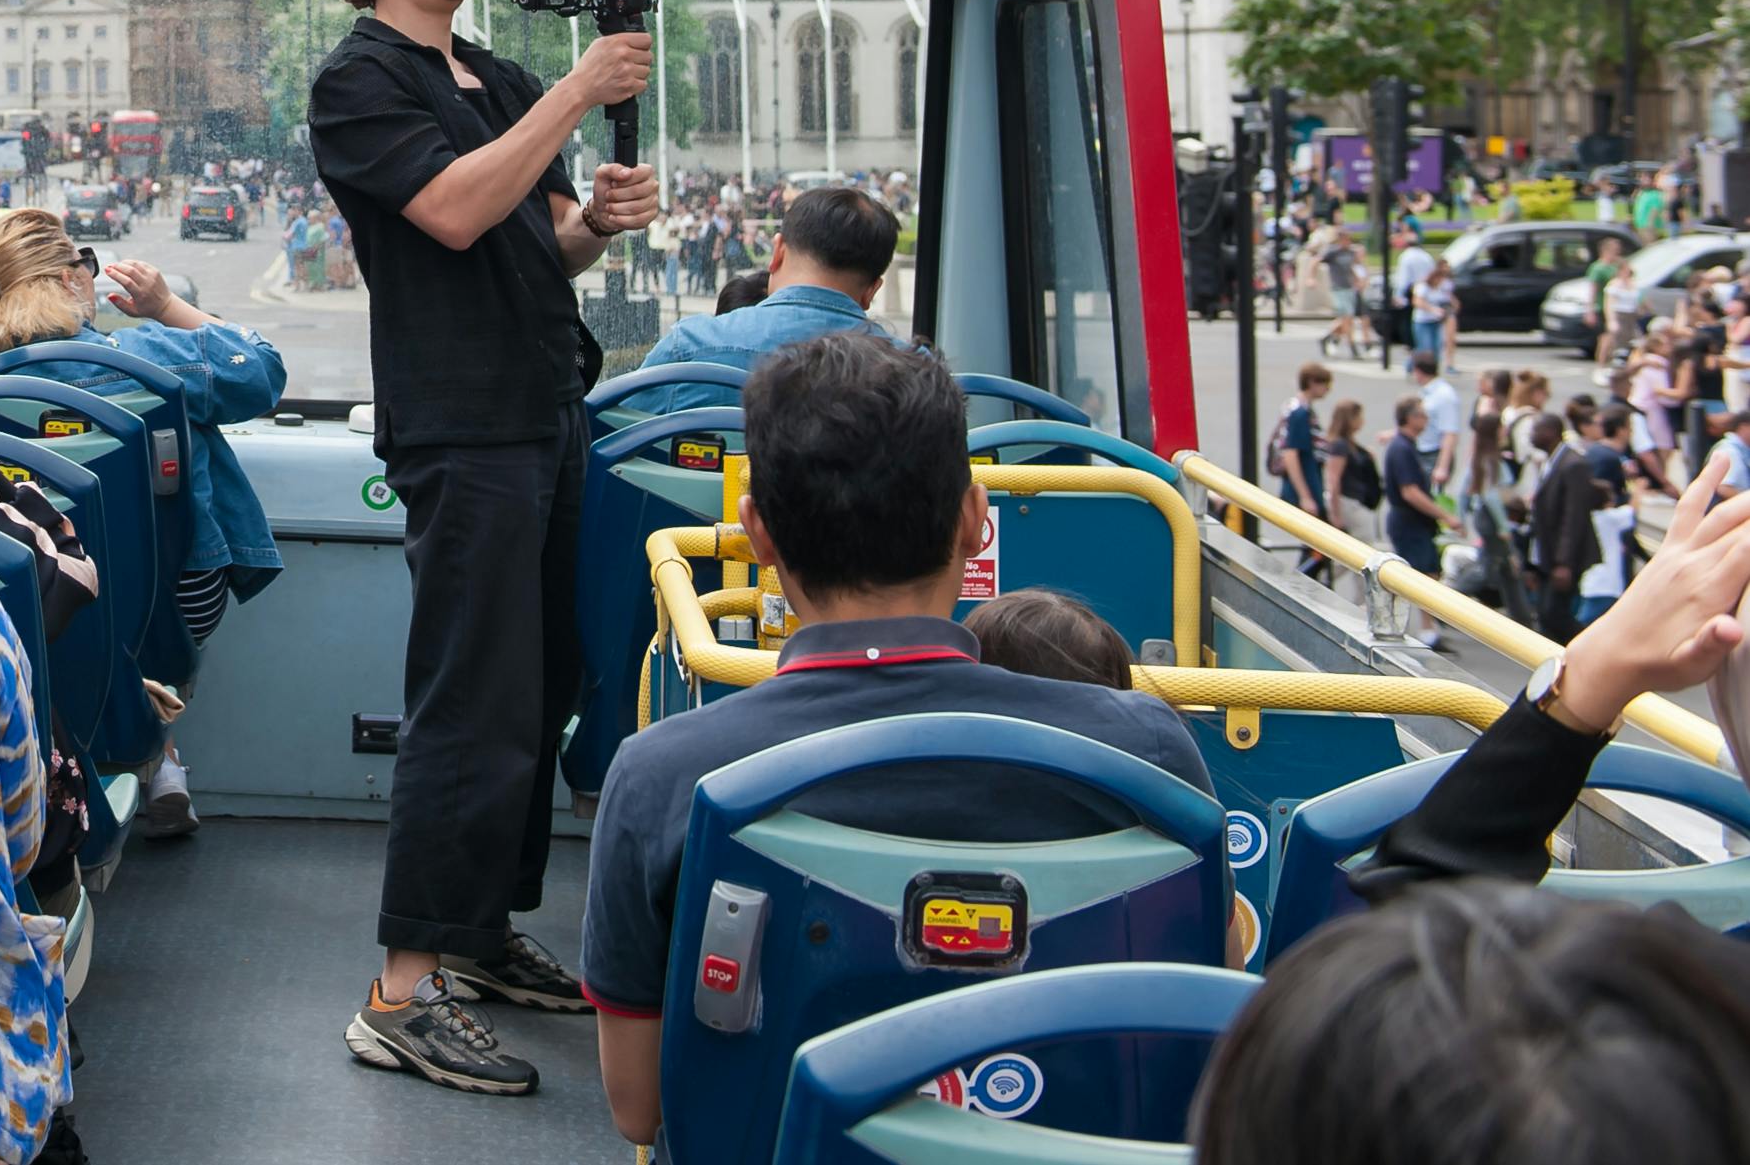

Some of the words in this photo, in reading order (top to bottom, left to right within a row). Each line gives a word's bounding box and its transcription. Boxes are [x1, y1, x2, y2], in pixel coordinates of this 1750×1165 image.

[965, 561, 979, 570] No
[963, 570, 993, 580] oking
[927, 916, 962, 925] CHANNEL
[708, 968, 732, 982] STOP
